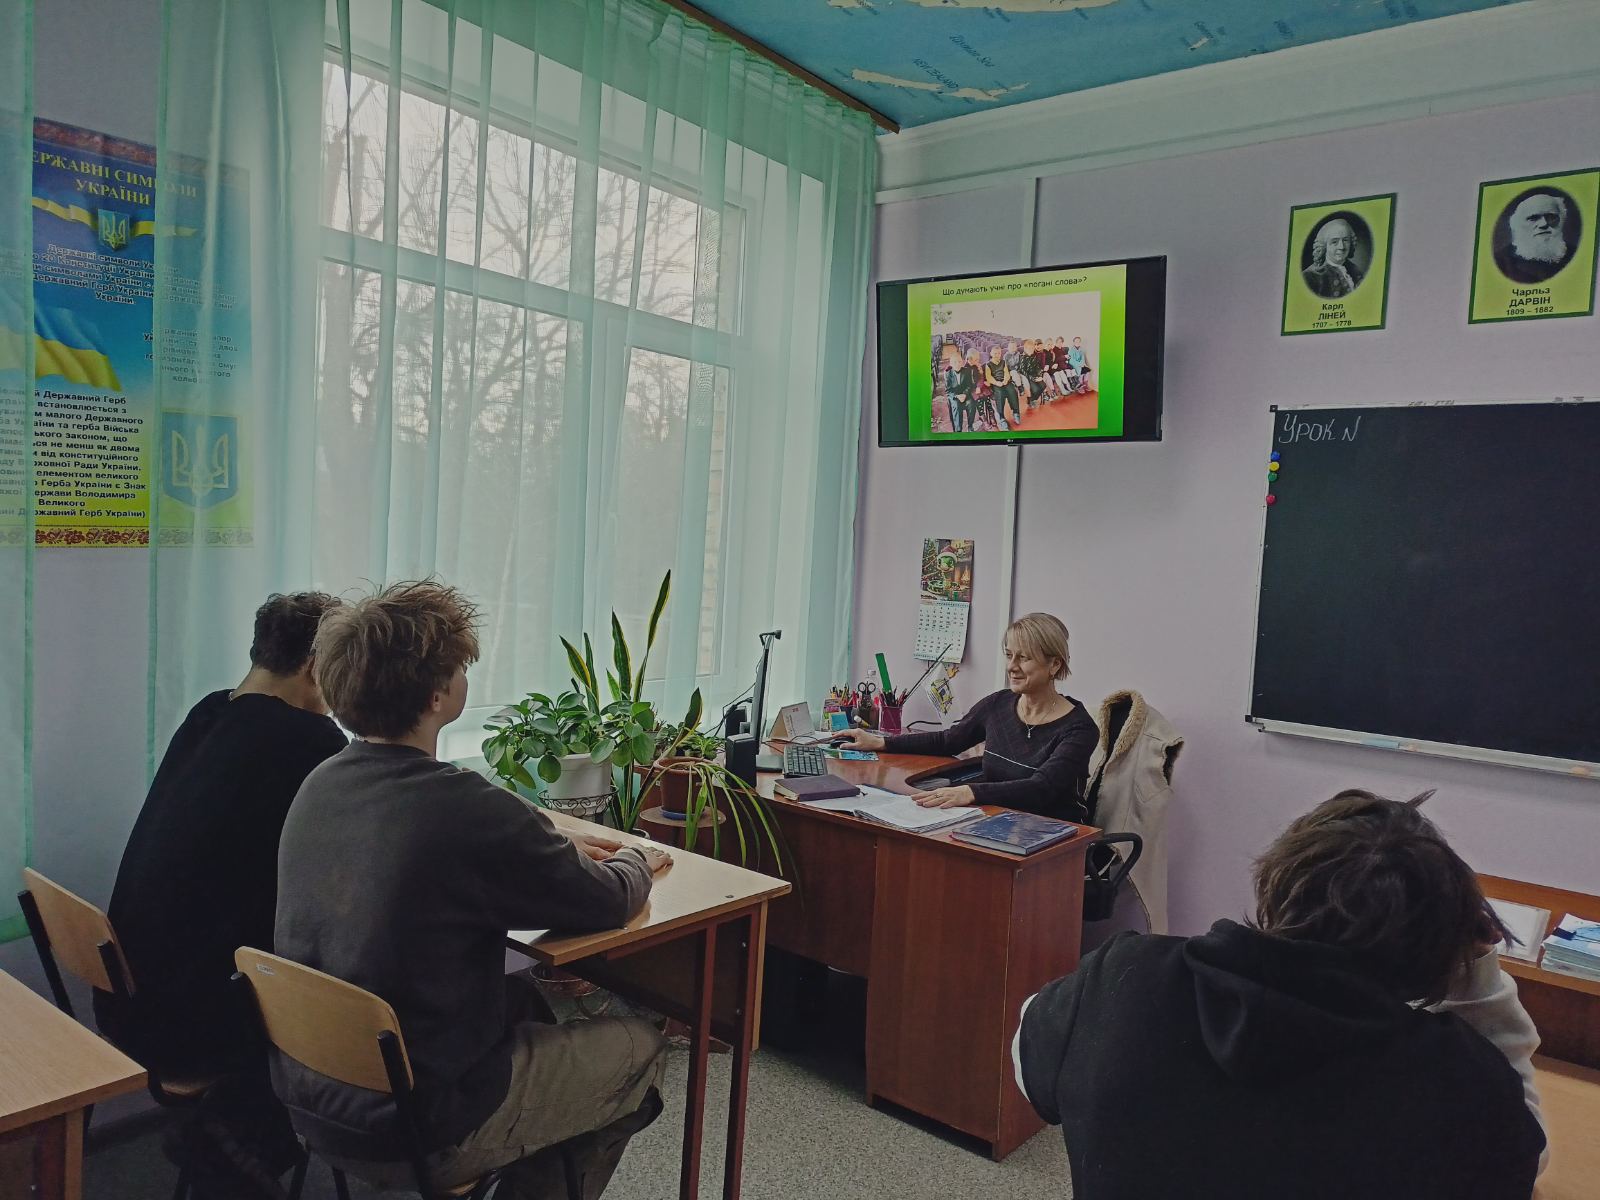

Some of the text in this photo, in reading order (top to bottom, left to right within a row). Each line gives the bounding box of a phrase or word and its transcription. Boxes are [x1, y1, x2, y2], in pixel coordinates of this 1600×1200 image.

[33, 151, 110, 178] ЕРЖАВНІ
[75, 179, 150, 205] УКРАЇНИ
[47, 244, 96, 260] Державні
[100, 255, 140, 267] символи
[58, 256, 116, 272] Конституції
[45, 265, 102, 279] символами
[105, 273, 142, 287] України
[91, 281, 114, 291] Герб
[942, 288, 955, 296] Що
[956, 286, 988, 296] думають
[1007, 283, 1022, 292] про
[1512, 287, 1550, 297] Чарльз
[1322, 303, 1344, 311] Карл
[1509, 296, 1551, 308] ДАРВІН
[1318, 310, 1346, 320] ЛІНЕЙ
[1506, 308, 1525, 316] 1809
[1535, 306, 1554, 314] 1882
[43, 390, 101, 402] Державний
[103, 395, 126, 405] Герб
[37, 401, 119, 414] встановлюється
[46, 412, 82, 420] малого
[85, 413, 143, 425] Державного
[72, 423, 100, 431] герба
[103, 425, 139, 434] Війська
[66, 432, 110, 442] законом,
[113, 435, 128, 443] що
[66, 442, 94, 450] менш
[41, 450, 56, 458] від
[59, 452, 139, 462] конституційного
[74, 461, 98, 470] Ради
[101, 462, 141, 471] України.
[37, 470, 139, 480] елементом великого
[41, 479, 71, 487] Герба
[74, 480, 112, 489] України
[34, 490, 72, 499] ержави
[75, 490, 136, 499] Володимира
[38, 499, 85, 507] Великого
[80, 509, 103, 517] Герб
[105, 510, 146, 519] України)
